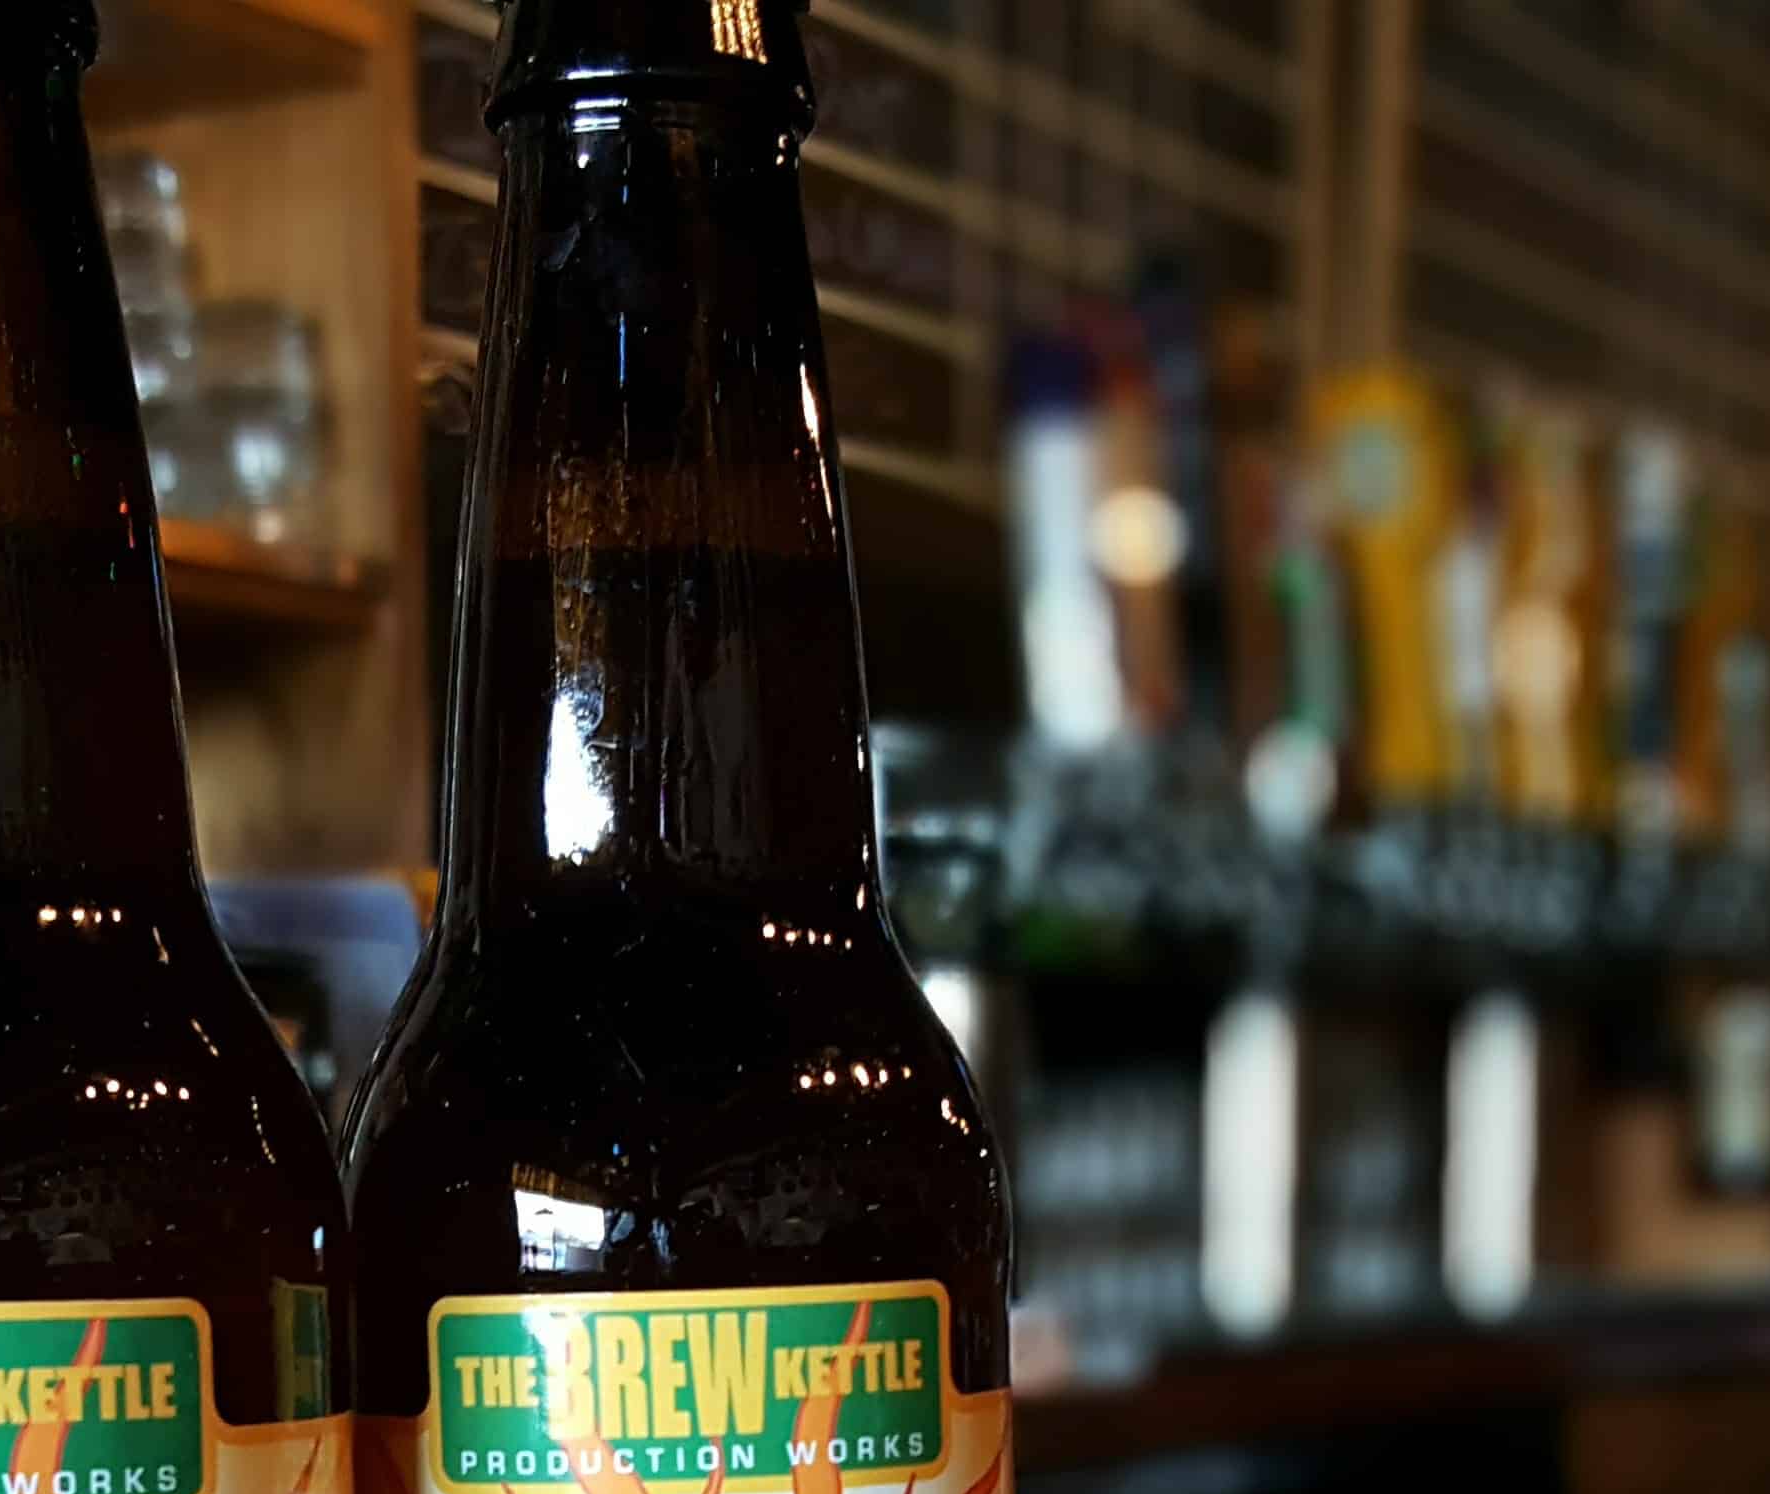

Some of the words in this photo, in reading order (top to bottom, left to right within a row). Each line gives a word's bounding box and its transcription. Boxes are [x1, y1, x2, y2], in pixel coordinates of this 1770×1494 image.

[455, 1355, 540, 1409] THE
[544, 1310, 768, 1441] BREW
[774, 1339, 923, 1401] KETTLE
[460, 1443, 757, 1477] PRODUCTION
[786, 1431, 925, 1467] WORKS
